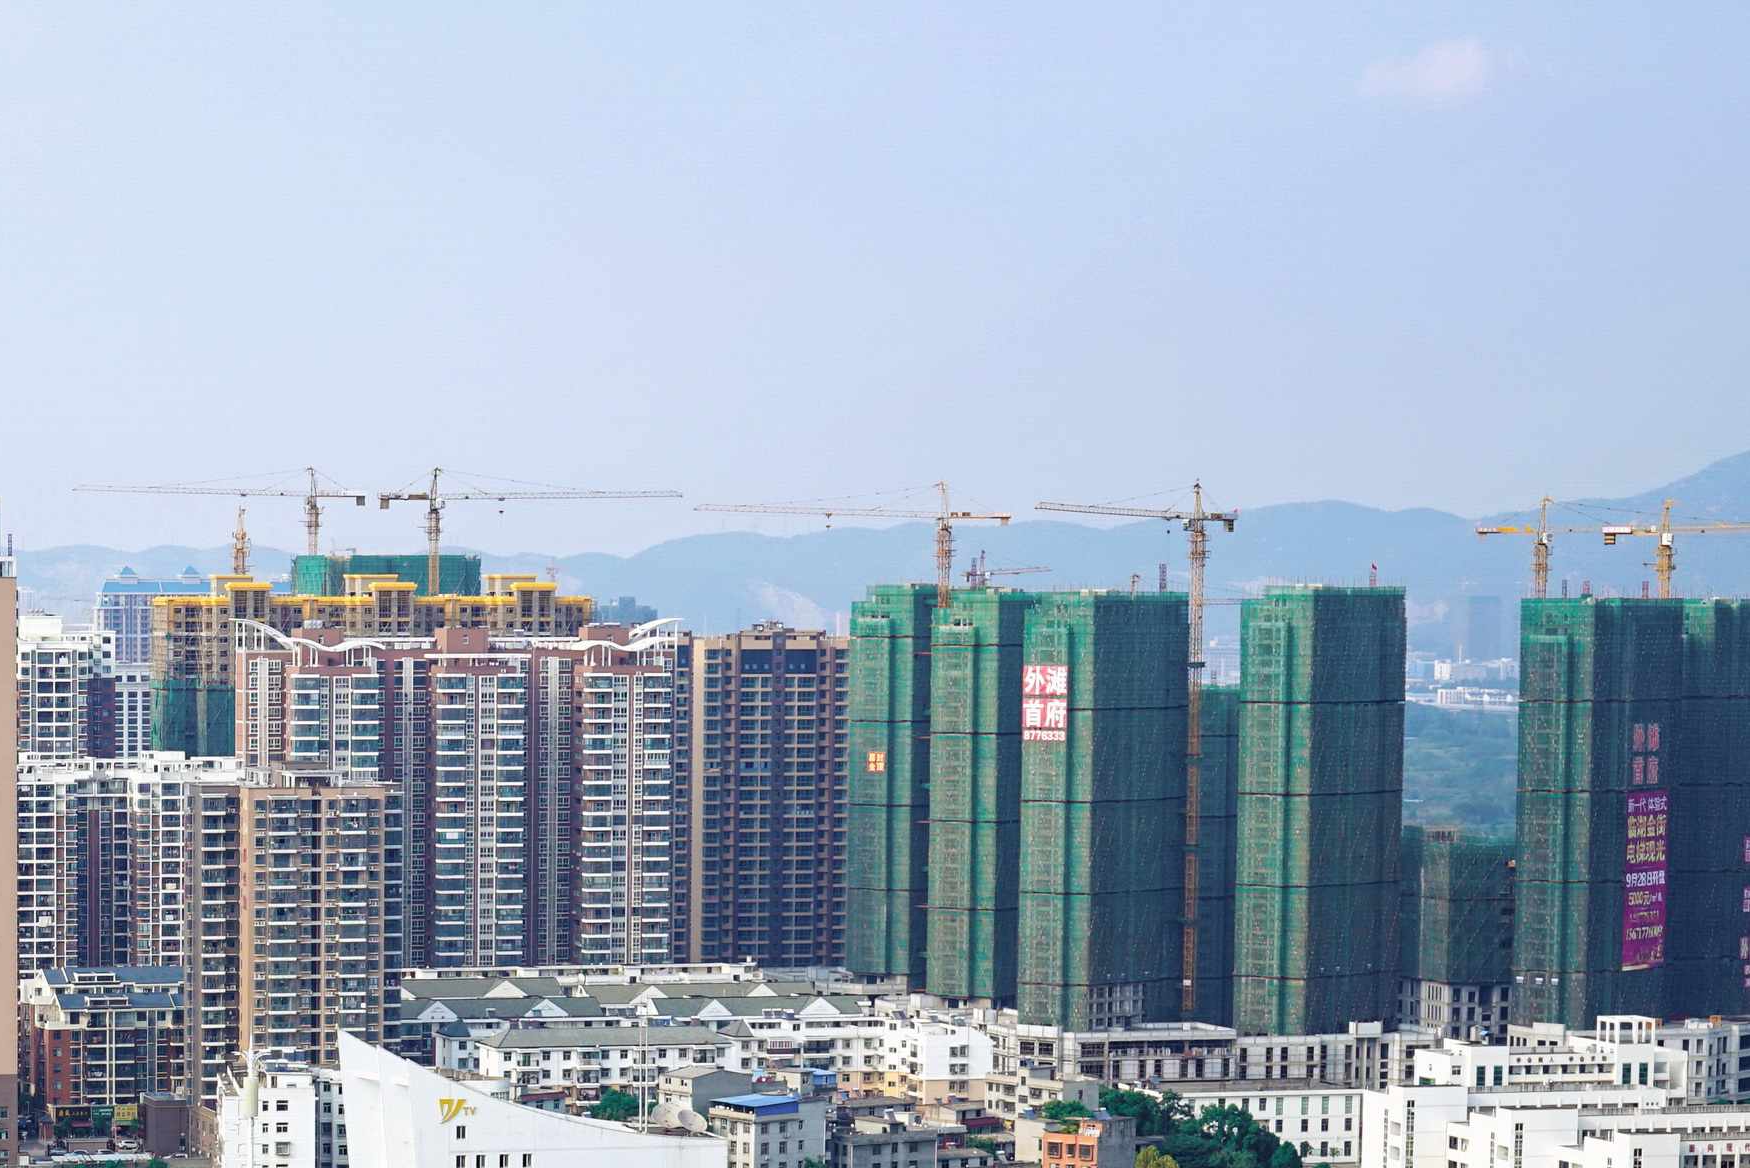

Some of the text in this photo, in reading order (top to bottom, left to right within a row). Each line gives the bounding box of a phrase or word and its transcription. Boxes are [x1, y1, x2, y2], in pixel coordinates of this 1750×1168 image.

[1023, 665, 1068, 696] 外滩
[1022, 701, 1068, 728] 首府
[1023, 730, 1066, 742] 8776333
[1626, 870, 1666, 888] 9月28日开盘
